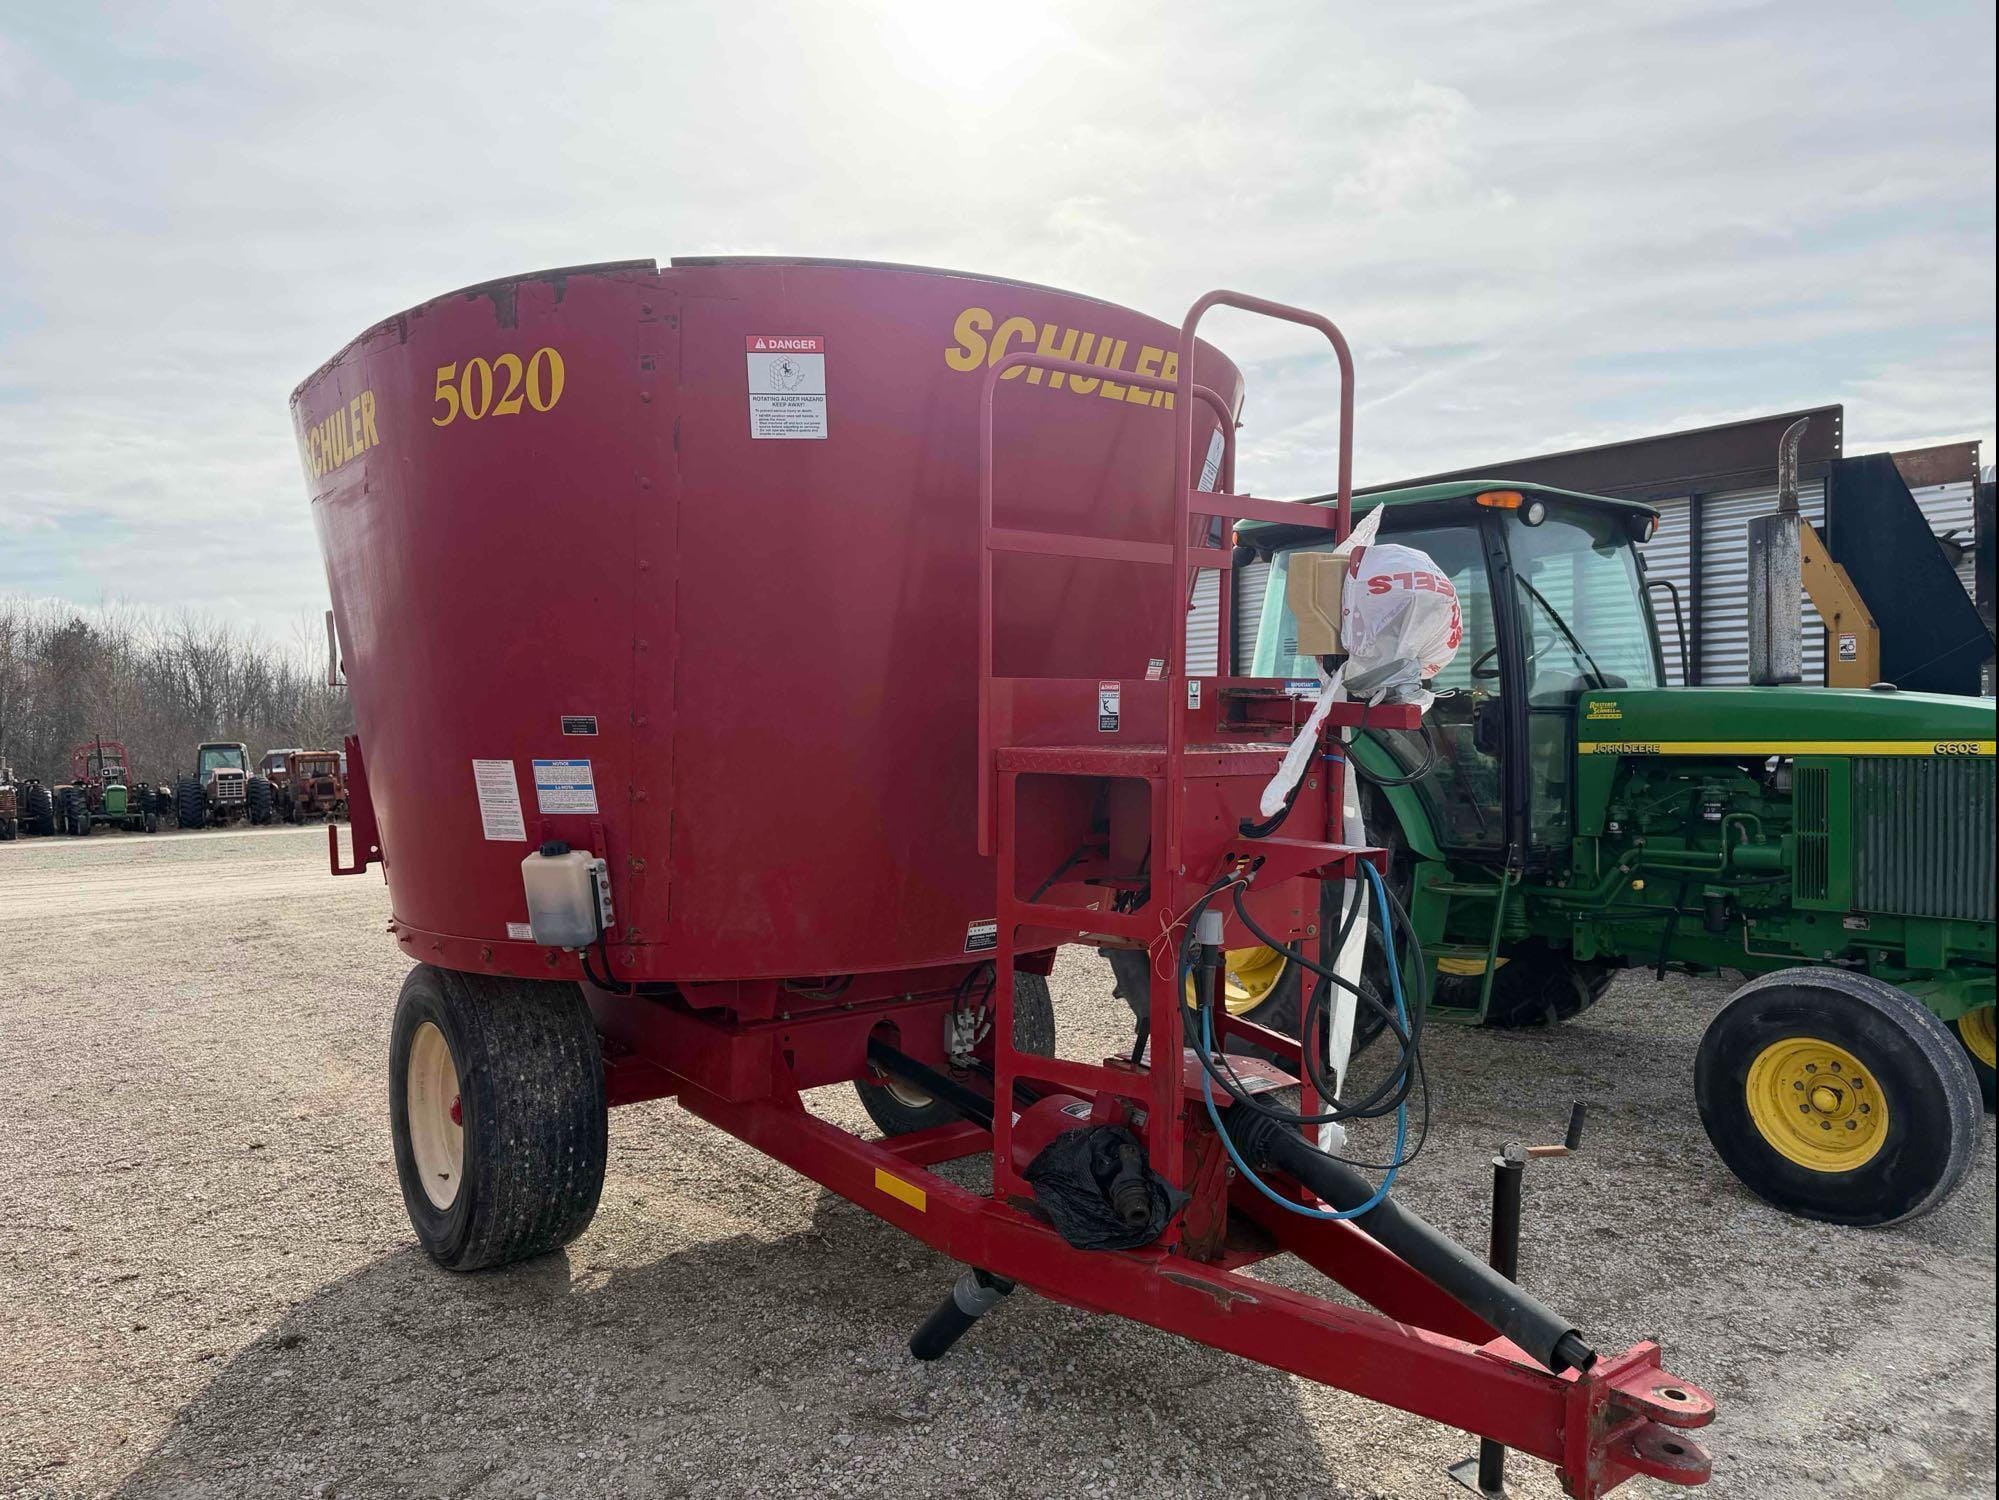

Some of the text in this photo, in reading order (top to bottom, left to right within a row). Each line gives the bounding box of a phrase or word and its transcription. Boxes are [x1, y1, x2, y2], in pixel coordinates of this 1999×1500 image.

[769, 339, 816, 350] DANGER
[944, 306, 1179, 410] SCHULER
[431, 346, 566, 428] 5020
[303, 390, 381, 482] SCHULER
[1594, 743, 1660, 753] JOHN DEERE
[1934, 742, 1980, 755] 6603
